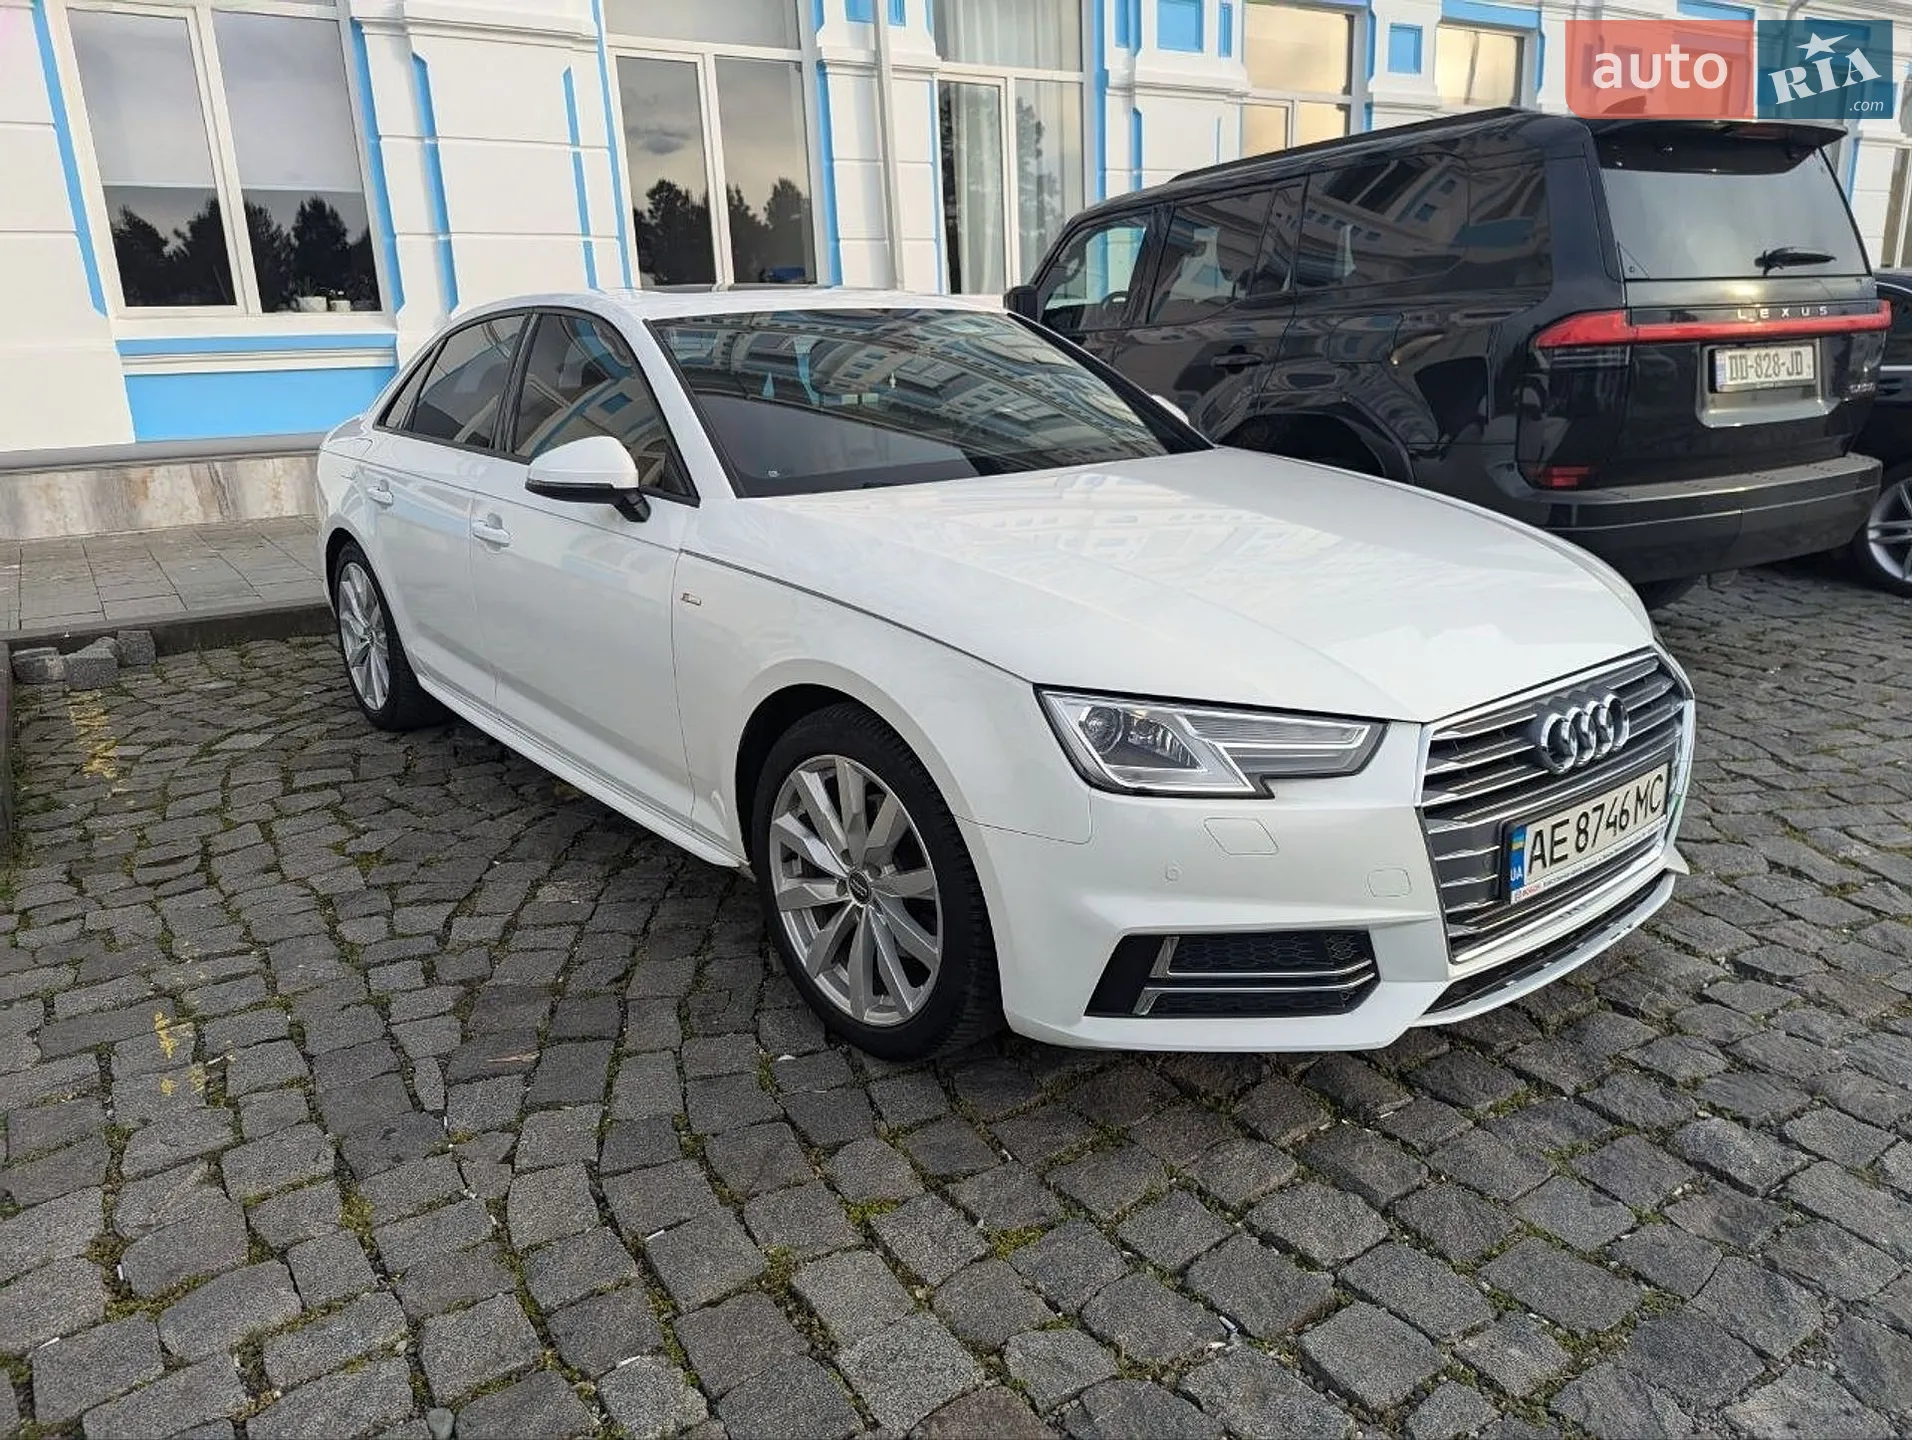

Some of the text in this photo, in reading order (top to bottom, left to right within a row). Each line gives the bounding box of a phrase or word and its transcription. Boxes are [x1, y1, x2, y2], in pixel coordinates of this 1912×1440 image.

[1737, 305, 1829, 320] LEXUS
[1728, 351, 1803, 381] DD-828-JD
[1527, 818, 1570, 874] AE
[1574, 790, 1630, 853] 8746
[1632, 774, 1663, 824] MC
[1510, 865, 1524, 882] UA
